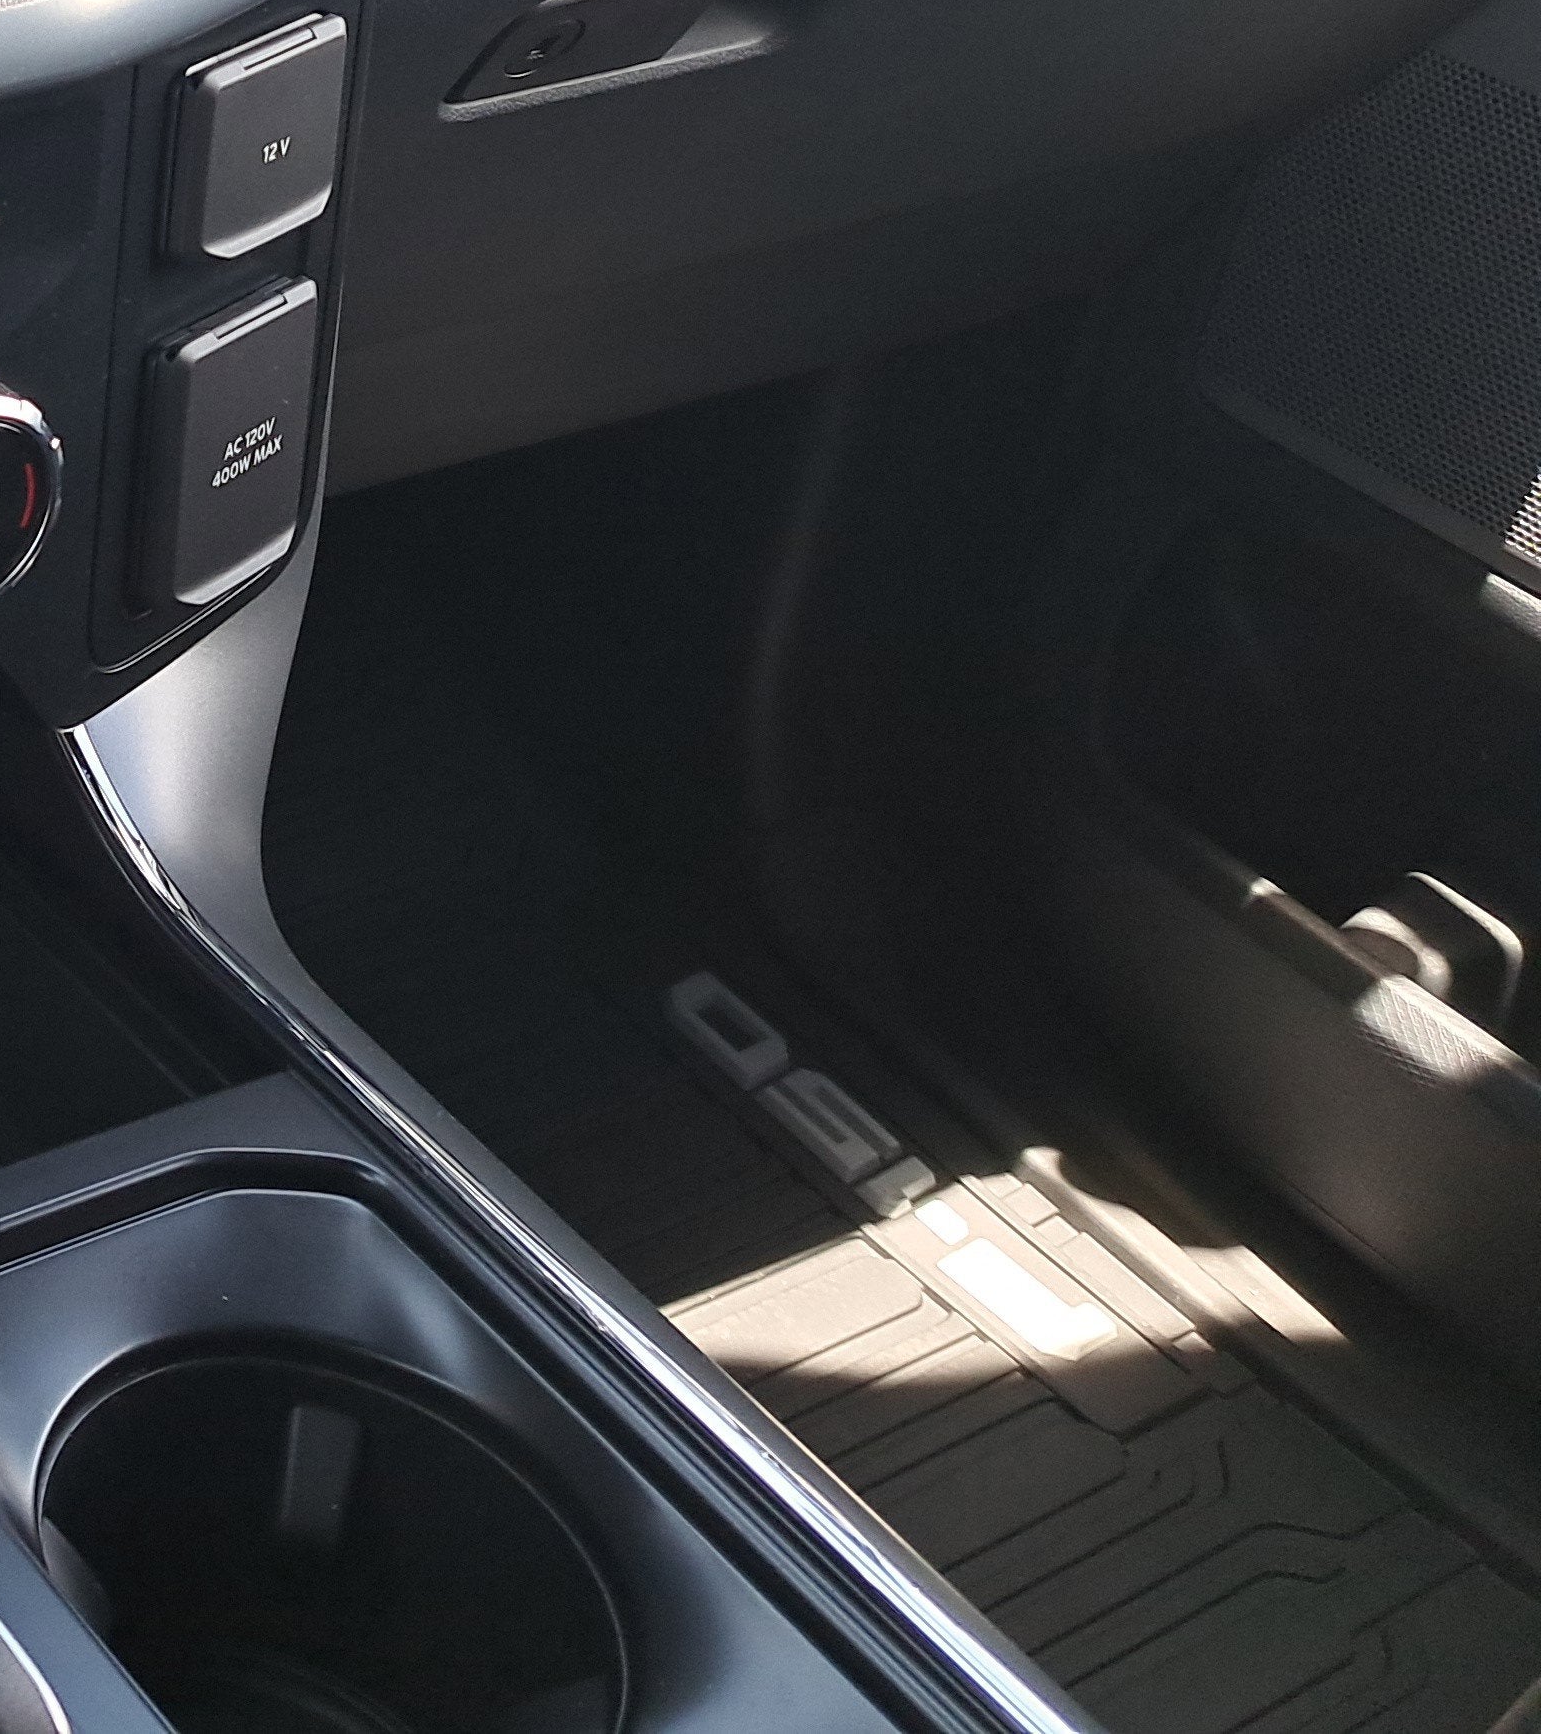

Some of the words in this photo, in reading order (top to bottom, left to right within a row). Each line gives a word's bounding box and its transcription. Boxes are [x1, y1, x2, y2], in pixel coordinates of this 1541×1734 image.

[212, 453, 251, 487] 400W
[252, 434, 283, 466] MAX
[224, 436, 243, 461] AC
[245, 417, 276, 448] 120V
